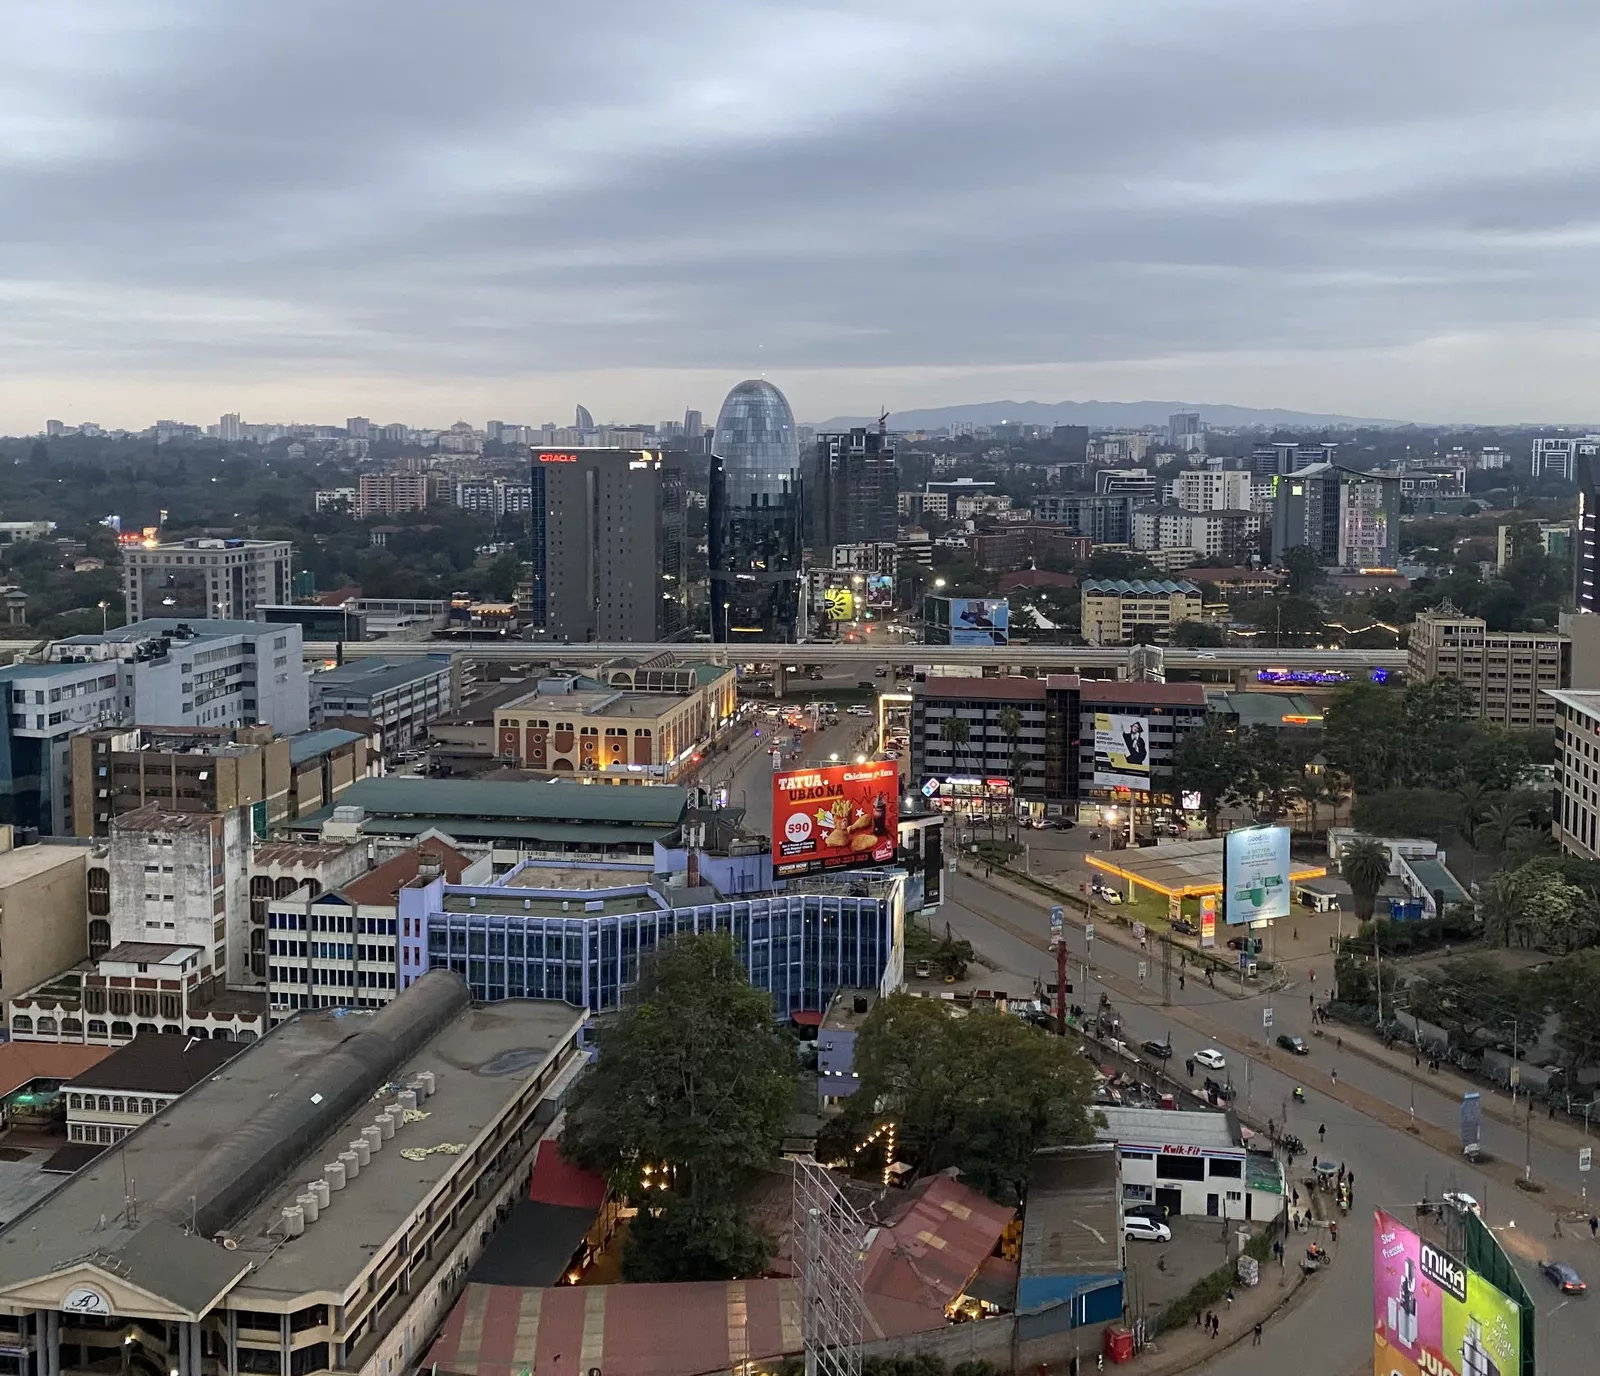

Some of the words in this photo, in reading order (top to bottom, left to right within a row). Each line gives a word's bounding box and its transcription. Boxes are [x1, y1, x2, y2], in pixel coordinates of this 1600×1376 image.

[539, 454, 577, 462] ORACLE
[778, 774, 822, 791] TATUA
[789, 786, 824, 801] UBAO
[827, 784, 844, 797] NA
[788, 822, 810, 835] 590
[1163, 1144, 1200, 1156] Kwik-Fit
